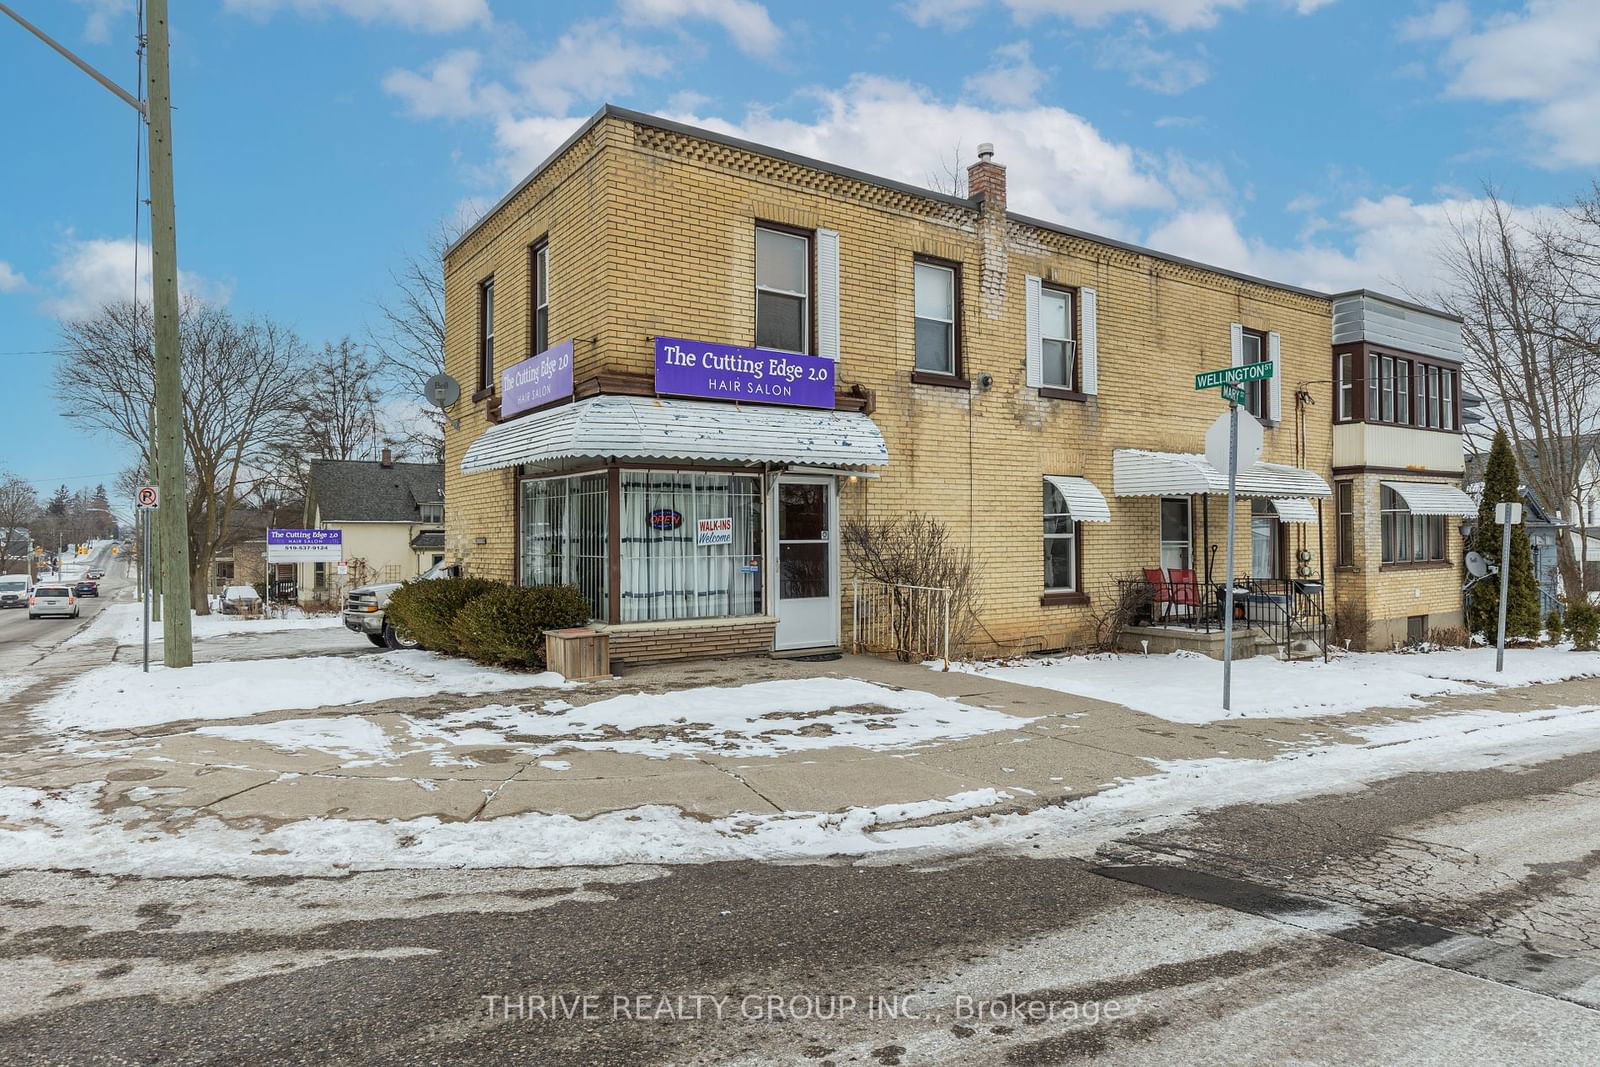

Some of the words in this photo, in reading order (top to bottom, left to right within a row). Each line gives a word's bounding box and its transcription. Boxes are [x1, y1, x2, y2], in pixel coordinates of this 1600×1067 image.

[664, 345, 697, 367] The
[702, 351, 764, 379] Cutting
[768, 358, 803, 383] Edge
[808, 367, 828, 382] 2.0
[503, 375, 514, 391] The
[515, 366, 540, 385] Cutting
[540, 357, 557, 379] Edge
[558, 353, 569, 371] 2.0
[1197, 364, 1264, 387] WELLINGTON
[532, 384, 551, 400] SALON
[708, 378, 741, 393] HAIR
[747, 382, 792, 397] SALON
[1223, 385, 1239, 400] MARY
[650, 516, 680, 524] OPEN
[699, 519, 731, 532] WALK-INS
[285, 531, 311, 539] Cutting
[312, 531, 327, 539] Edge
[698, 531, 731, 544] Welcome
